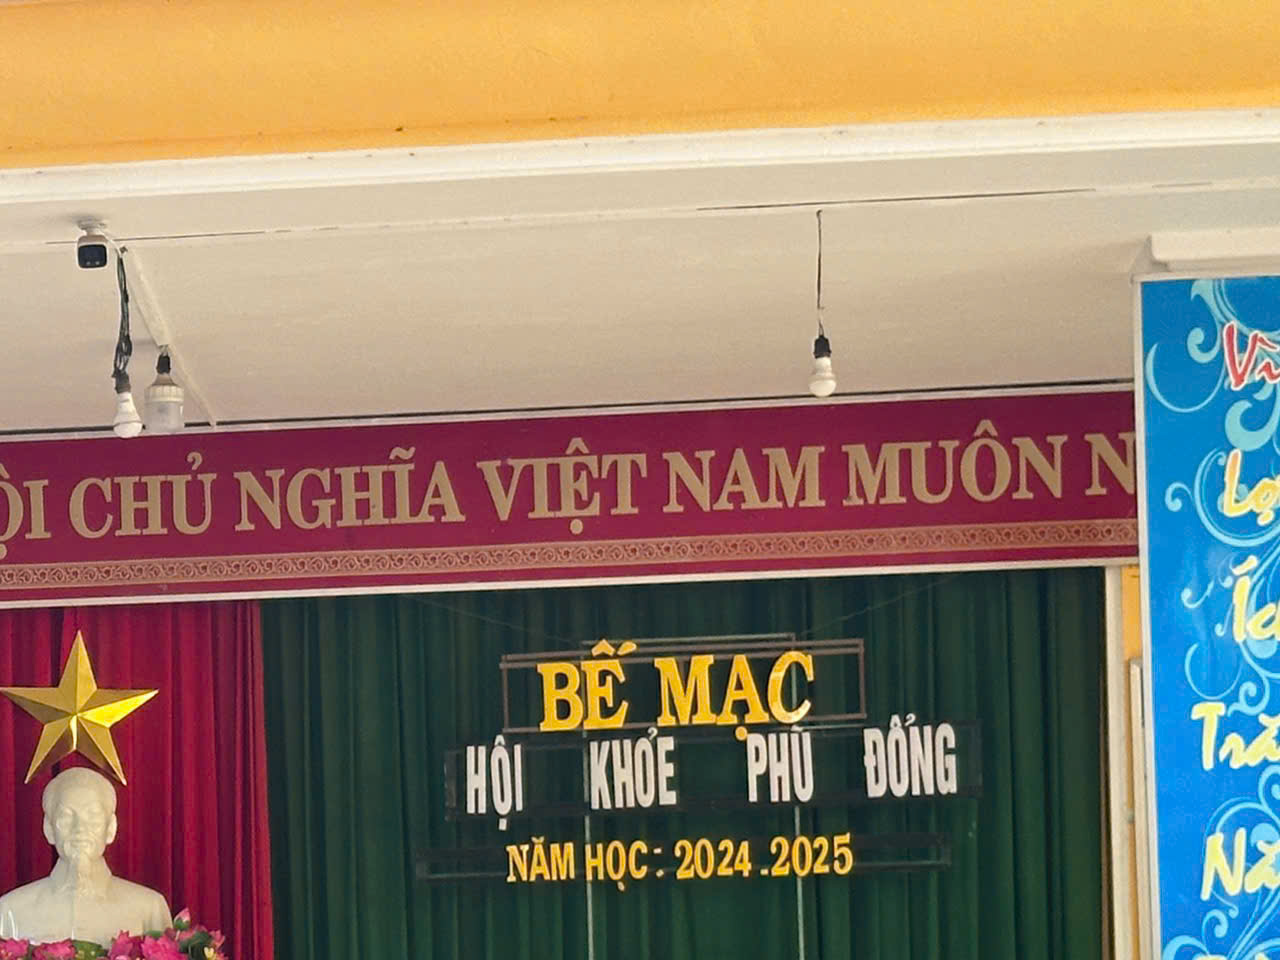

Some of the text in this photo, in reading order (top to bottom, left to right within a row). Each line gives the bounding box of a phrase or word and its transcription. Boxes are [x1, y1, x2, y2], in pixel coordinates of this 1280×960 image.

[69, 451, 217, 538] CHỦ
[234, 446, 465, 532] NGHĨA
[477, 437, 647, 534] VIỆT
[663, 446, 825, 512] NAM
[842, 419, 1068, 507] MUÔN
[537, 639, 815, 741] BẾ MẠC
[466, 734, 523, 830] HỘI
[589, 726, 677, 810] KHỎE
[863, 713, 957, 798] ĐỔNG
[506, 835, 576, 882] NĂM
